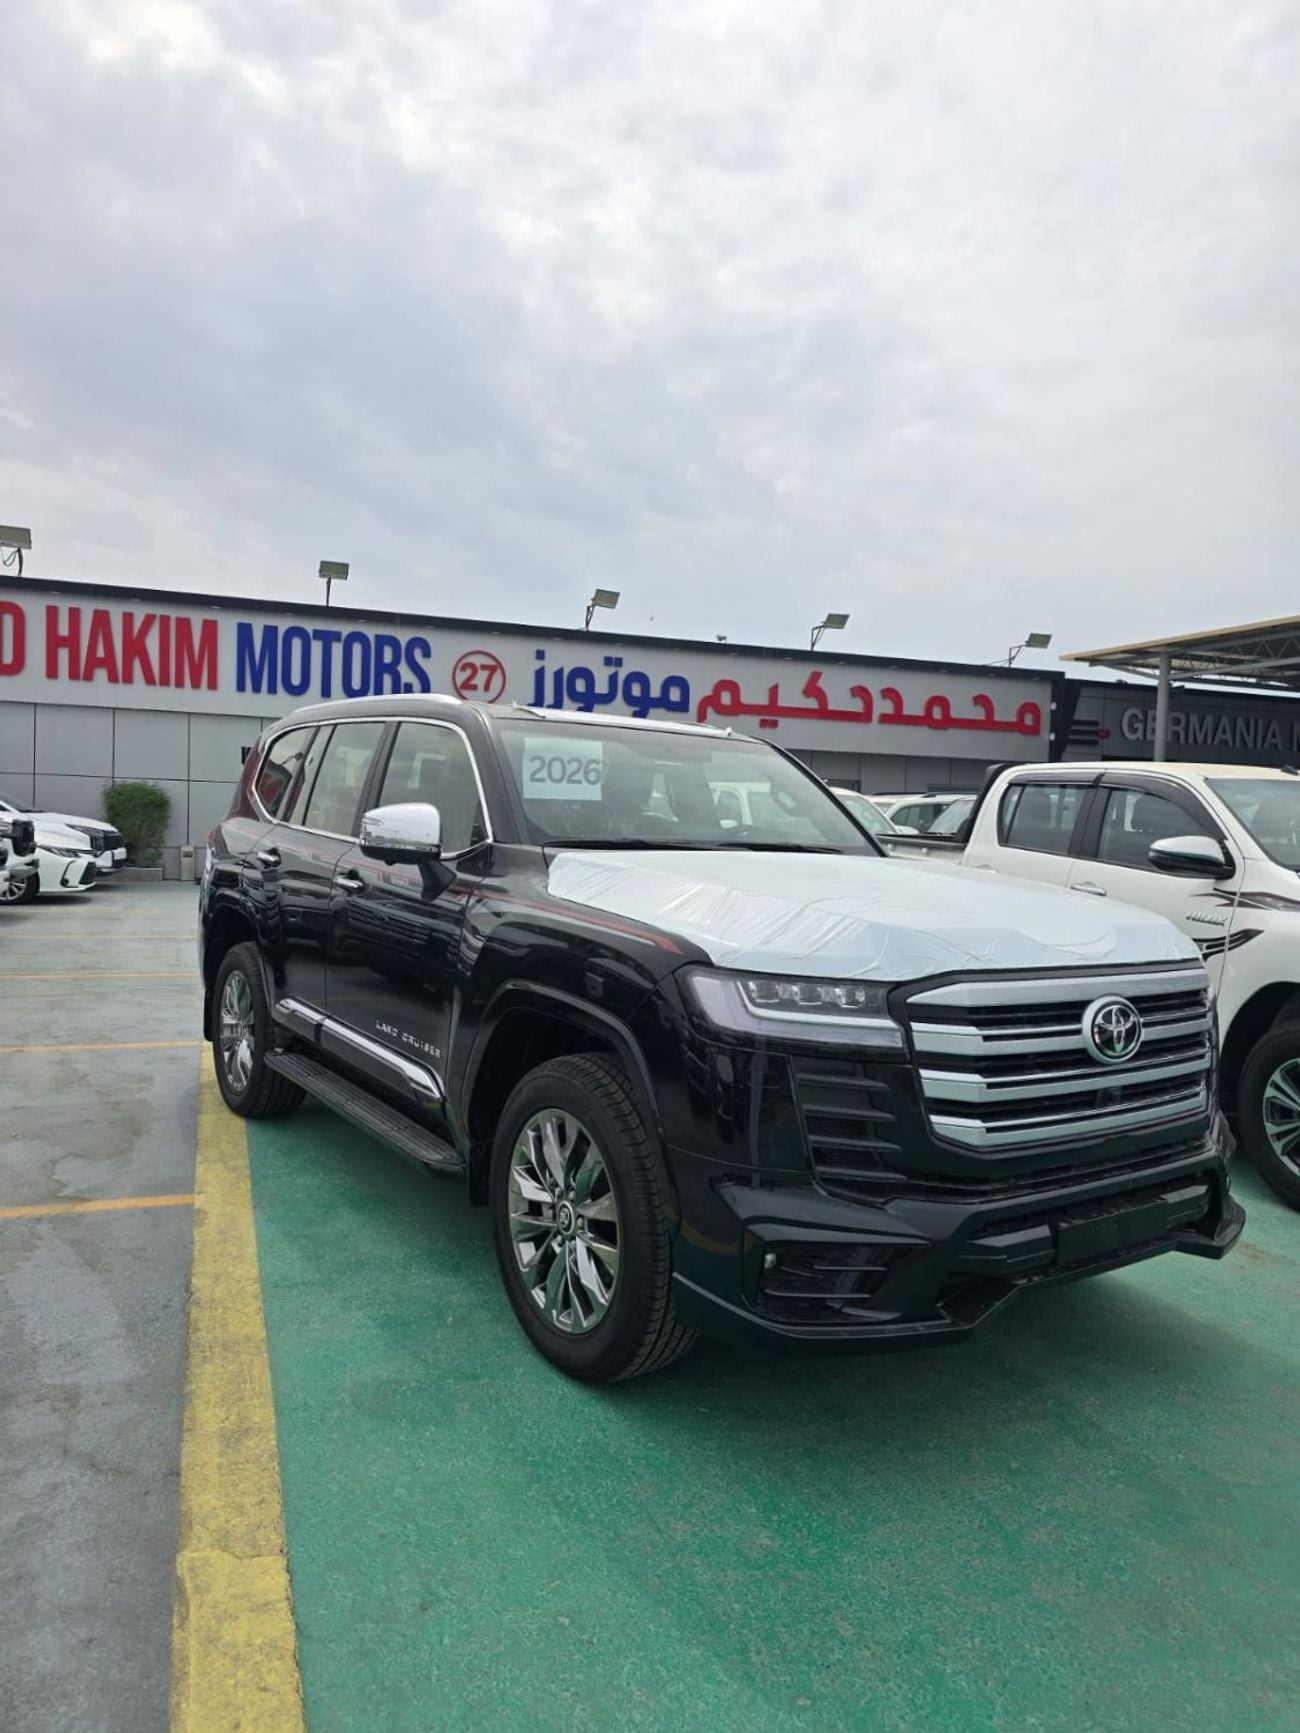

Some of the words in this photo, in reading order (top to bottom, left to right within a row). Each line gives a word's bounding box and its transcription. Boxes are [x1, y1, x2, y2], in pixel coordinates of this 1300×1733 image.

[46, 605, 218, 691] HAKIM
[236, 622, 432, 697] MOTORS
[459, 661, 499, 691] 27
[527, 649, 690, 718] موتورز
[529, 755, 601, 786] 2026
